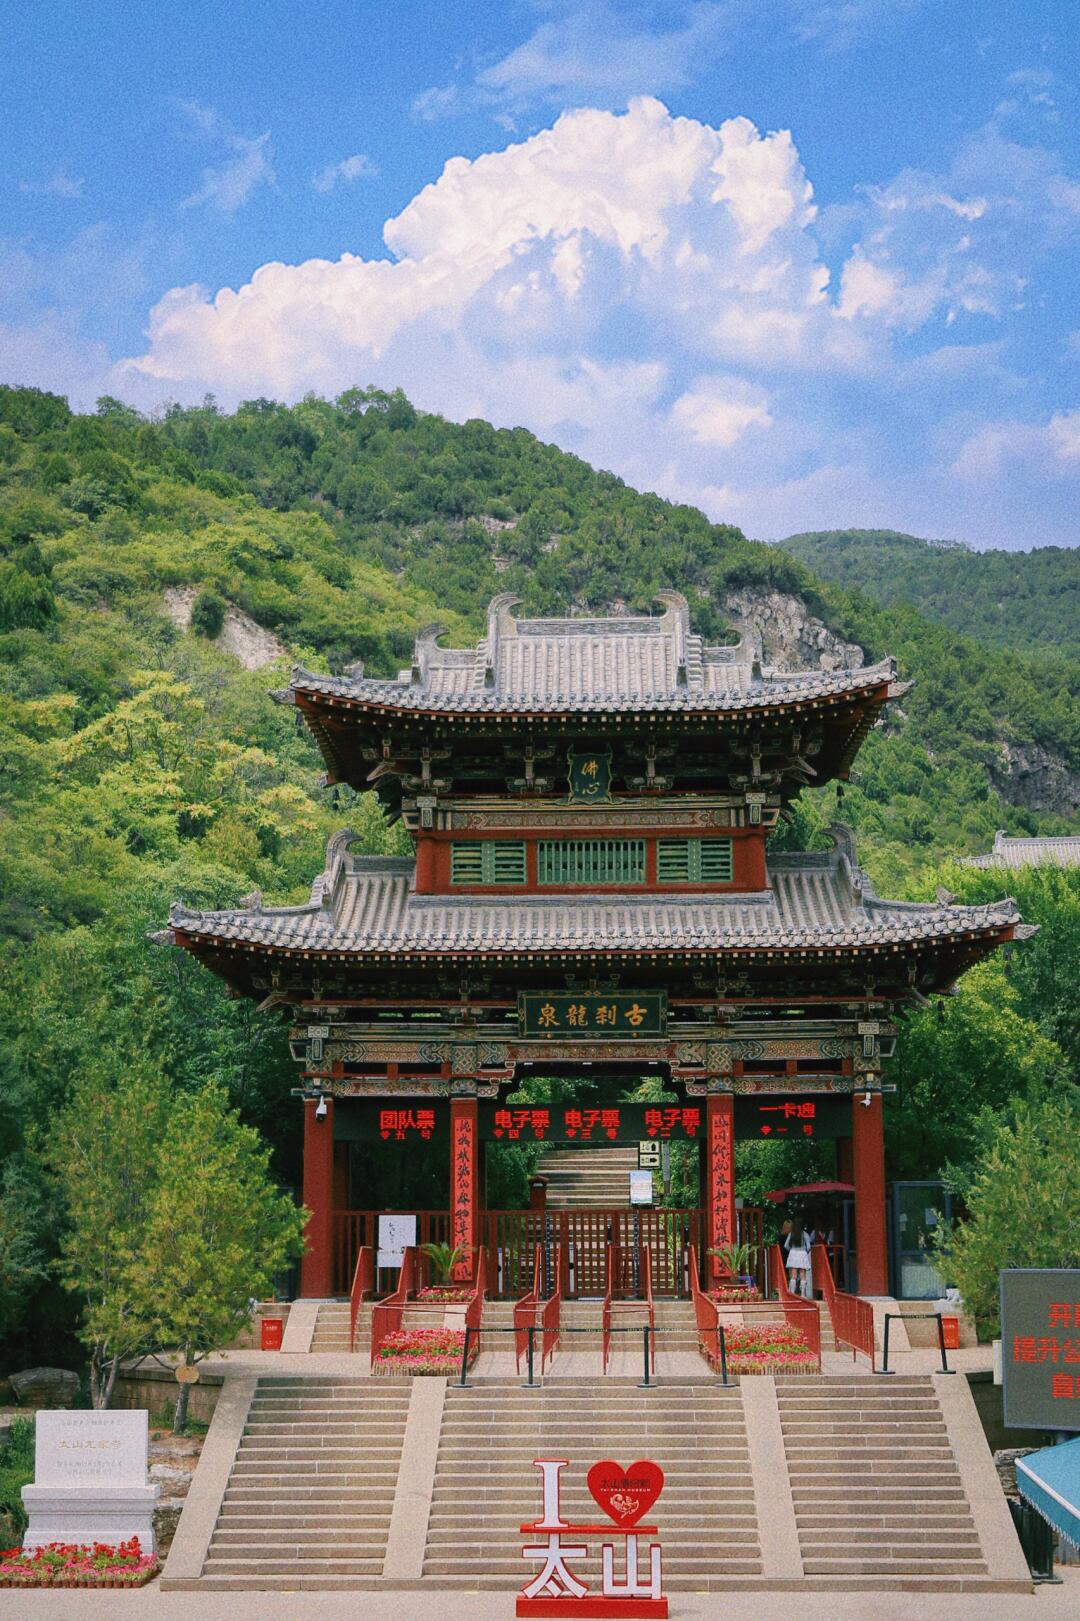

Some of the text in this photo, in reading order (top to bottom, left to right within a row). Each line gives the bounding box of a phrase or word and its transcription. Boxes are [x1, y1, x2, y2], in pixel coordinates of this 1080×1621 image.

[380, 1109, 435, 1129] 团队票
[495, 1109, 550, 1128] 电子票
[565, 1109, 620, 1128] 电子票
[645, 1108, 700, 1127] 电子票
[759, 1103, 816, 1118] 一卡通
[534, 1459, 569, 1528] I
[521, 1533, 662, 1599] 太山
